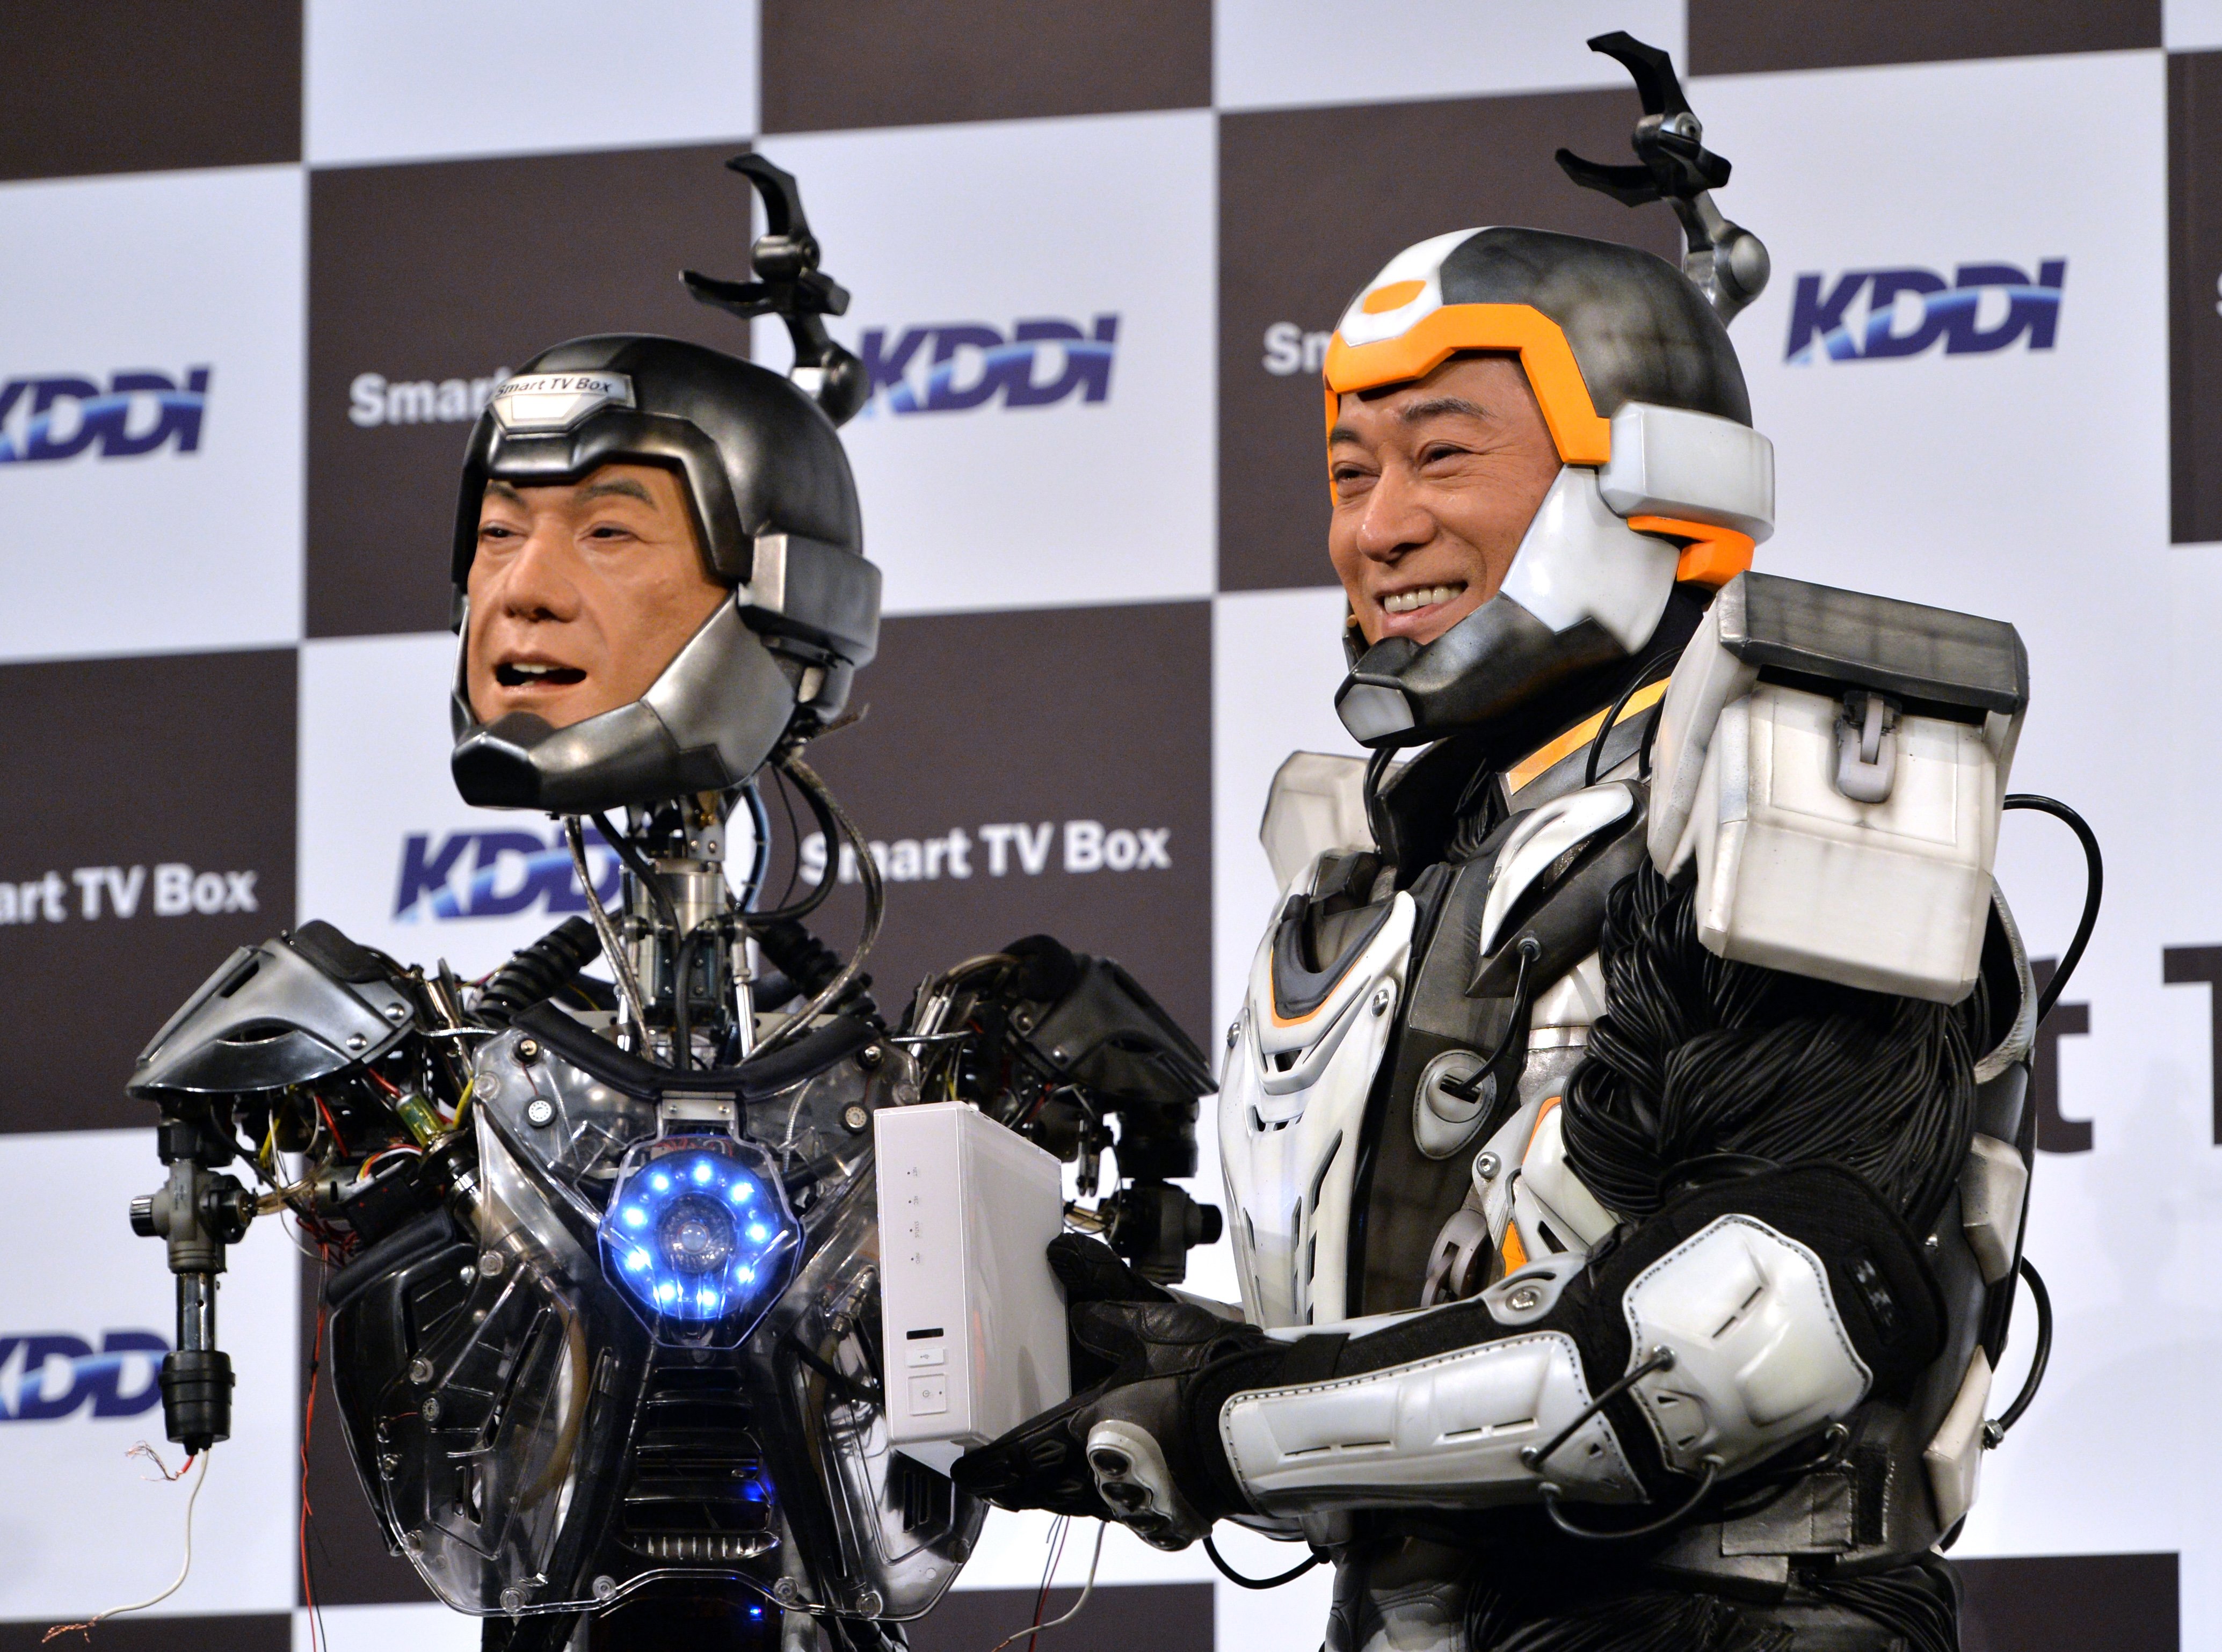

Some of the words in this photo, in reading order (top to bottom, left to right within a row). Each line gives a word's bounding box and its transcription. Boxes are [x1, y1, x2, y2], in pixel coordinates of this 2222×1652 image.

[1785, 257, 2067, 365] KDDI
[495, 379, 546, 397] Smart
[550, 377, 575, 389] TV
[576, 377, 612, 392] Box
[860, 314, 1119, 418] KDDI
[72, 864, 146, 921] TV
[153, 863, 258, 916] Box
[394, 829, 624, 922] KDD
[799, 827, 972, 886] Smart
[978, 821, 1055, 876] TV
[1063, 819, 1172, 873] Box
[0, 1333, 171, 1420] DD
